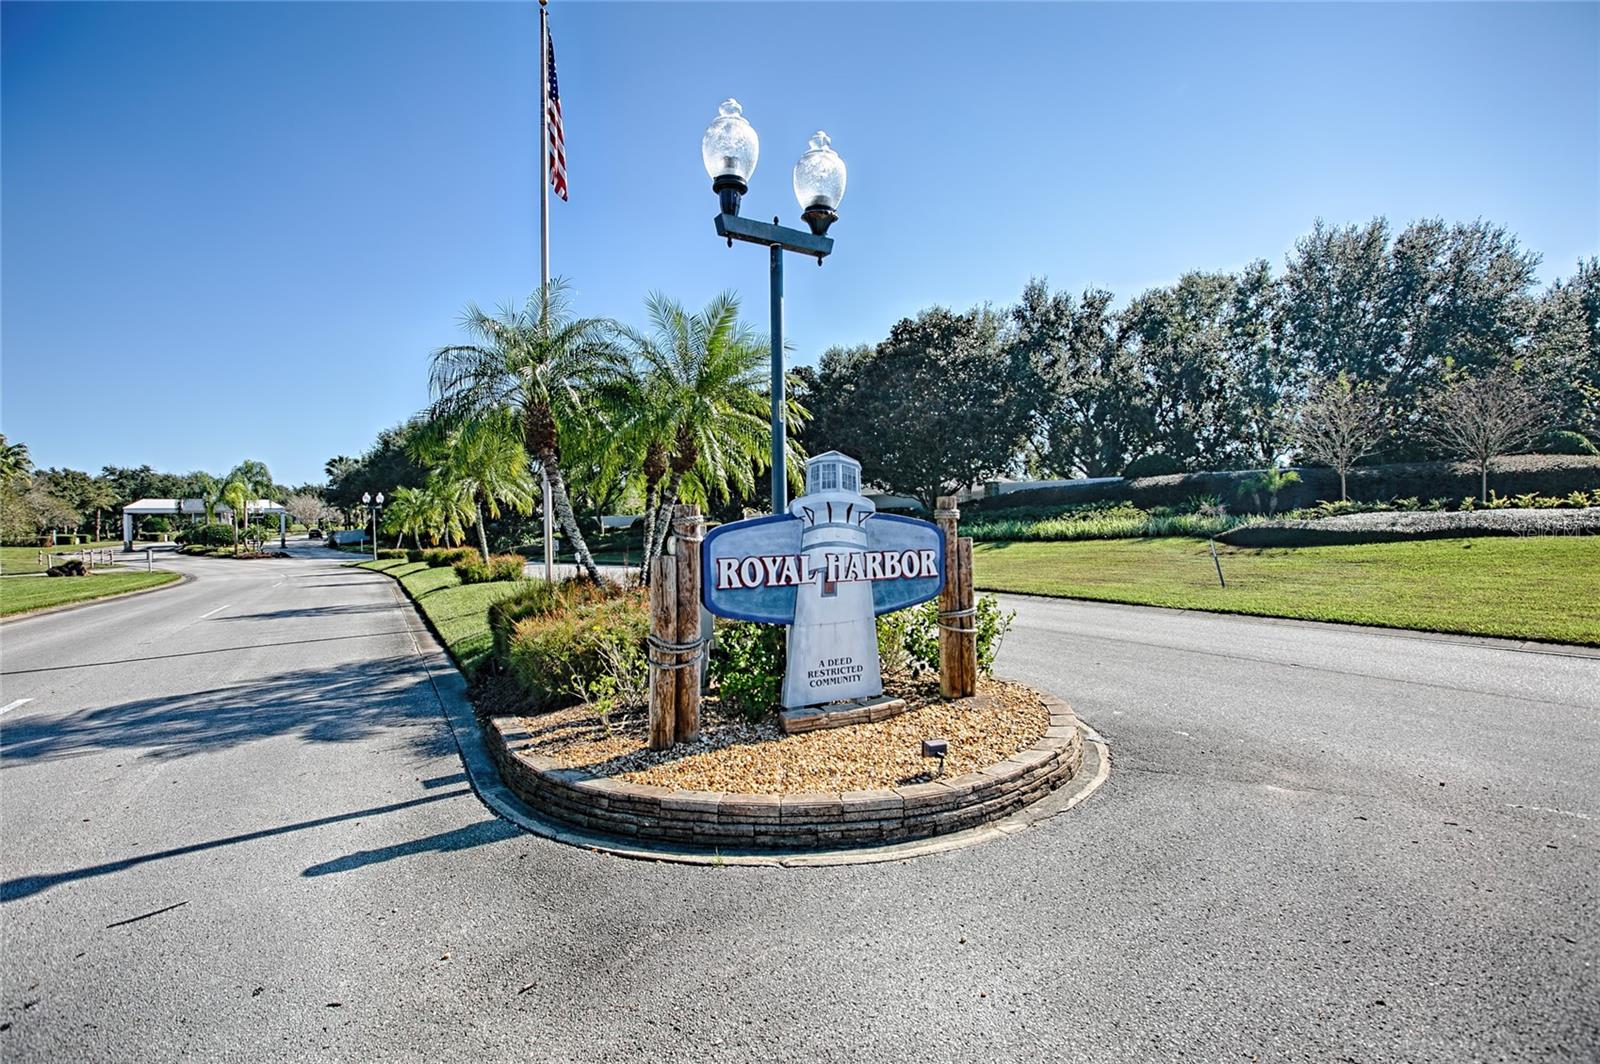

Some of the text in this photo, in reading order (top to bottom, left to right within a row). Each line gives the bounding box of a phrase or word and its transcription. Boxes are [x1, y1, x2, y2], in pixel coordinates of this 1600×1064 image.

[716, 550, 938, 590] ROYAL HARBOR
[819, 657, 852, 668] A DEED
[808, 665, 863, 679] RESTRICTED
[809, 674, 862, 687] COMMUNITY
